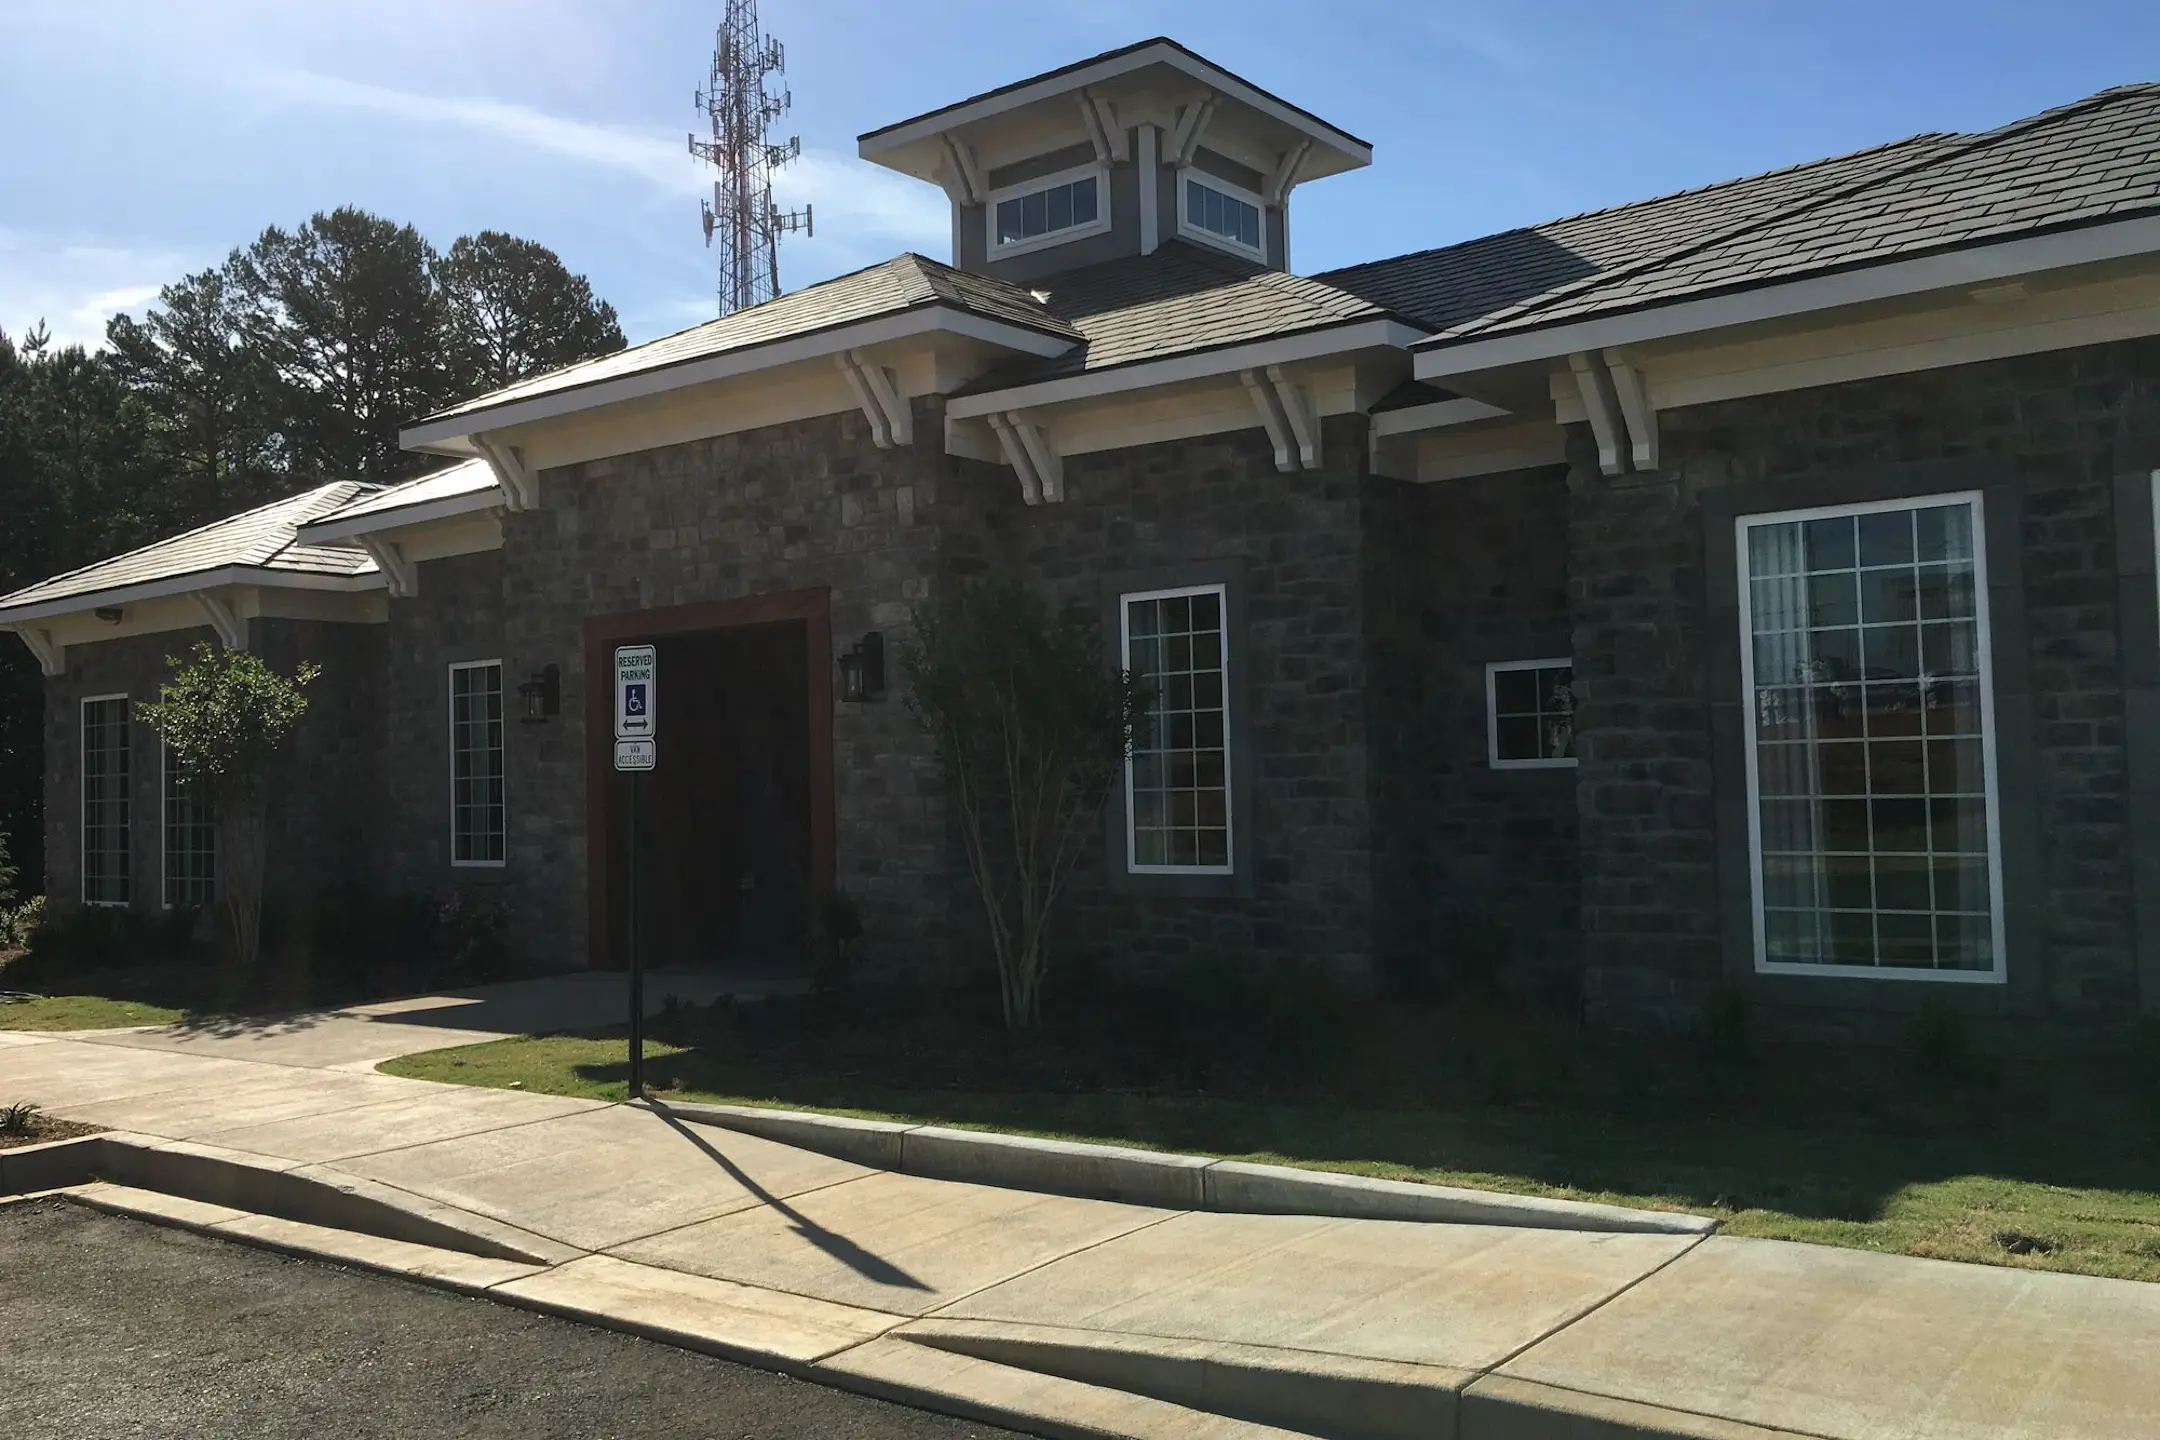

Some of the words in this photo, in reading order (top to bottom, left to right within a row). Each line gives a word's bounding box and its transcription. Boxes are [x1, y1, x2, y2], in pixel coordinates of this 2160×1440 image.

[618, 654, 652, 667] RESERVED
[620, 669, 650, 681] PARKING
[618, 755, 652, 765] ACCESSIBLE
